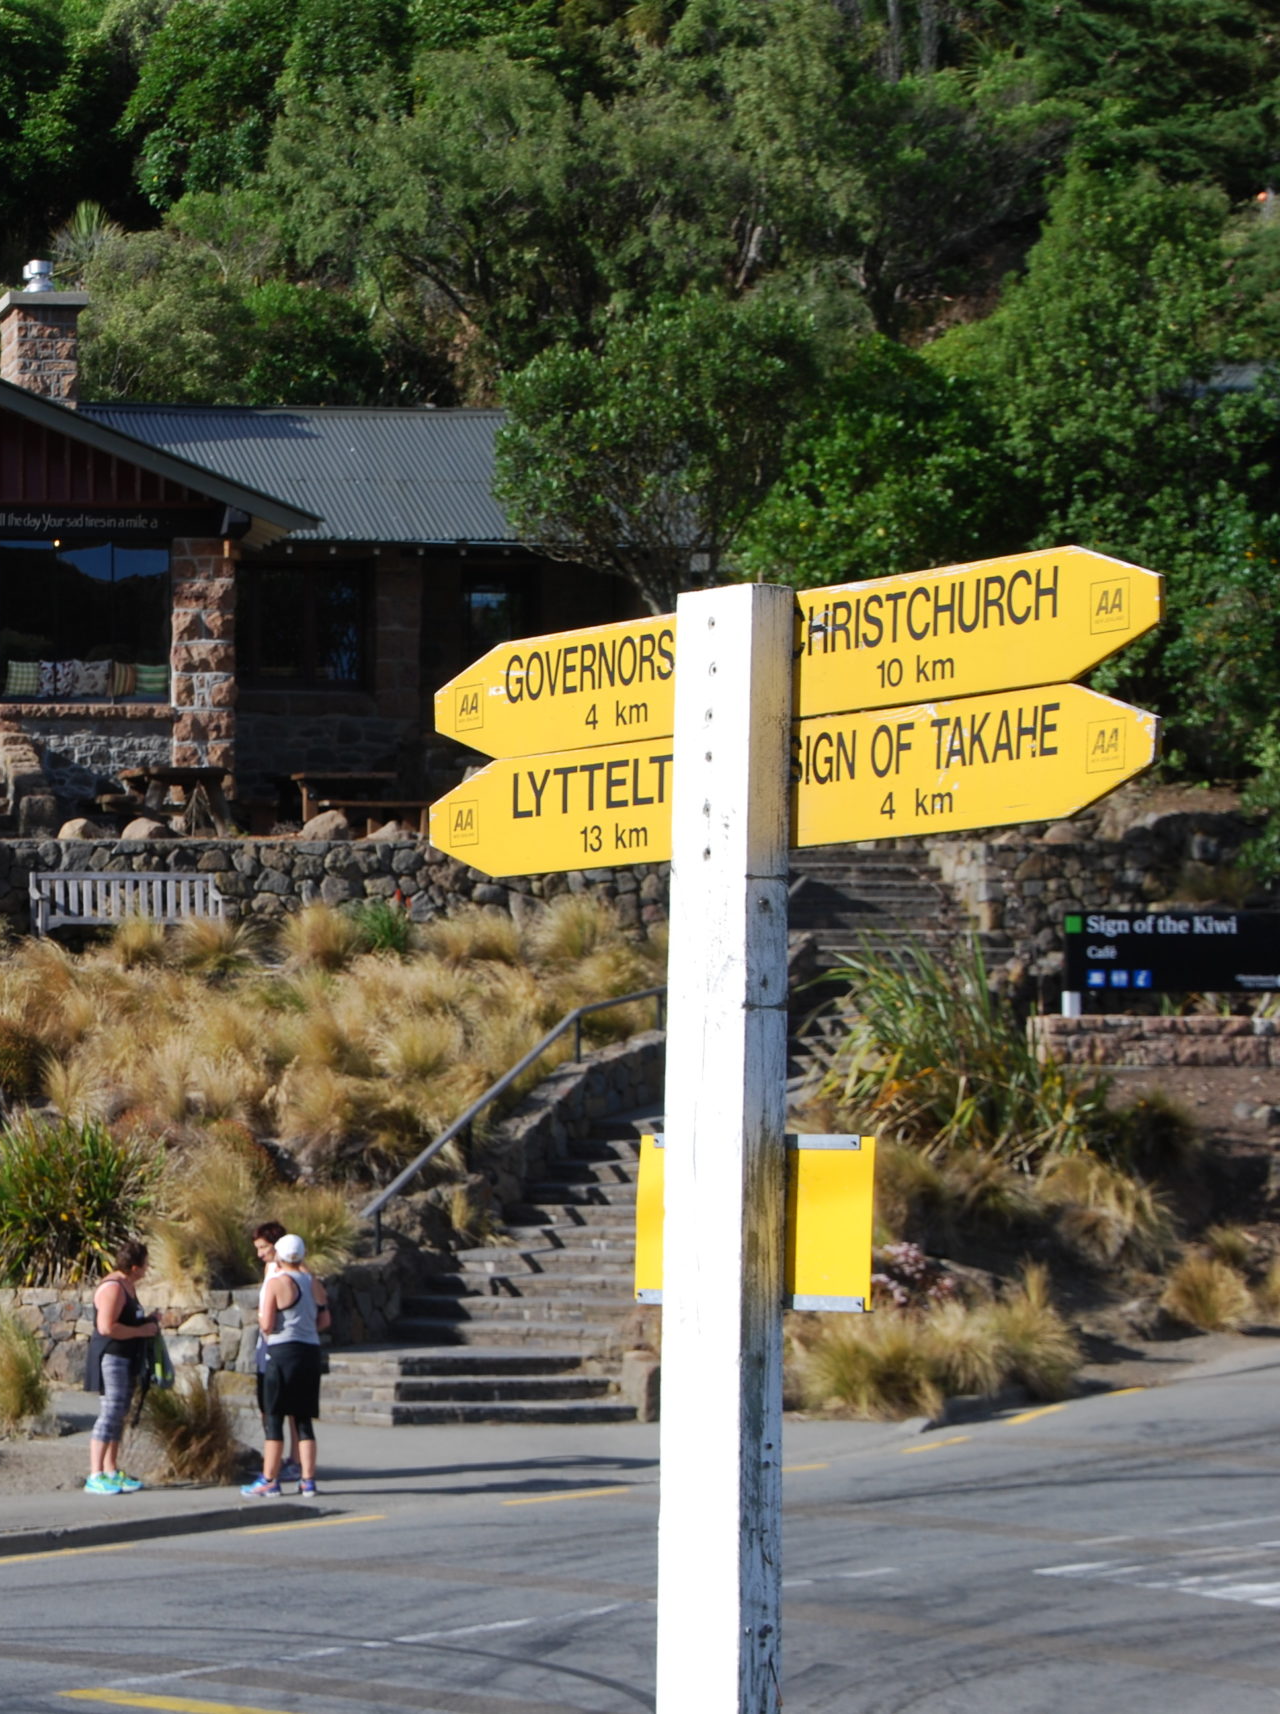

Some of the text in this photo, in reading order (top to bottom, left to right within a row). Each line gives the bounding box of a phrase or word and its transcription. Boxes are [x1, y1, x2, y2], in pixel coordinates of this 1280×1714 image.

[7, 513, 22, 527] the
[22, 514, 41, 531] day
[41, 514, 65, 532] Your
[65, 514, 83, 528] sad
[1095, 587, 1122, 617] AA
[505, 629, 675, 704] GOVERNORS
[876, 654, 955, 689] 10 km
[458, 692, 479, 717] AA
[585, 700, 649, 730] 4 km
[870, 721, 915, 779] OF
[930, 702, 1061, 770] TAKAHE
[1091, 727, 1119, 755] AA
[880, 788, 954, 820] 4 km
[453, 808, 474, 832] AA
[580, 822, 649, 853] 13 km
[1086, 914, 1238, 938] Sign of the Kiwi
